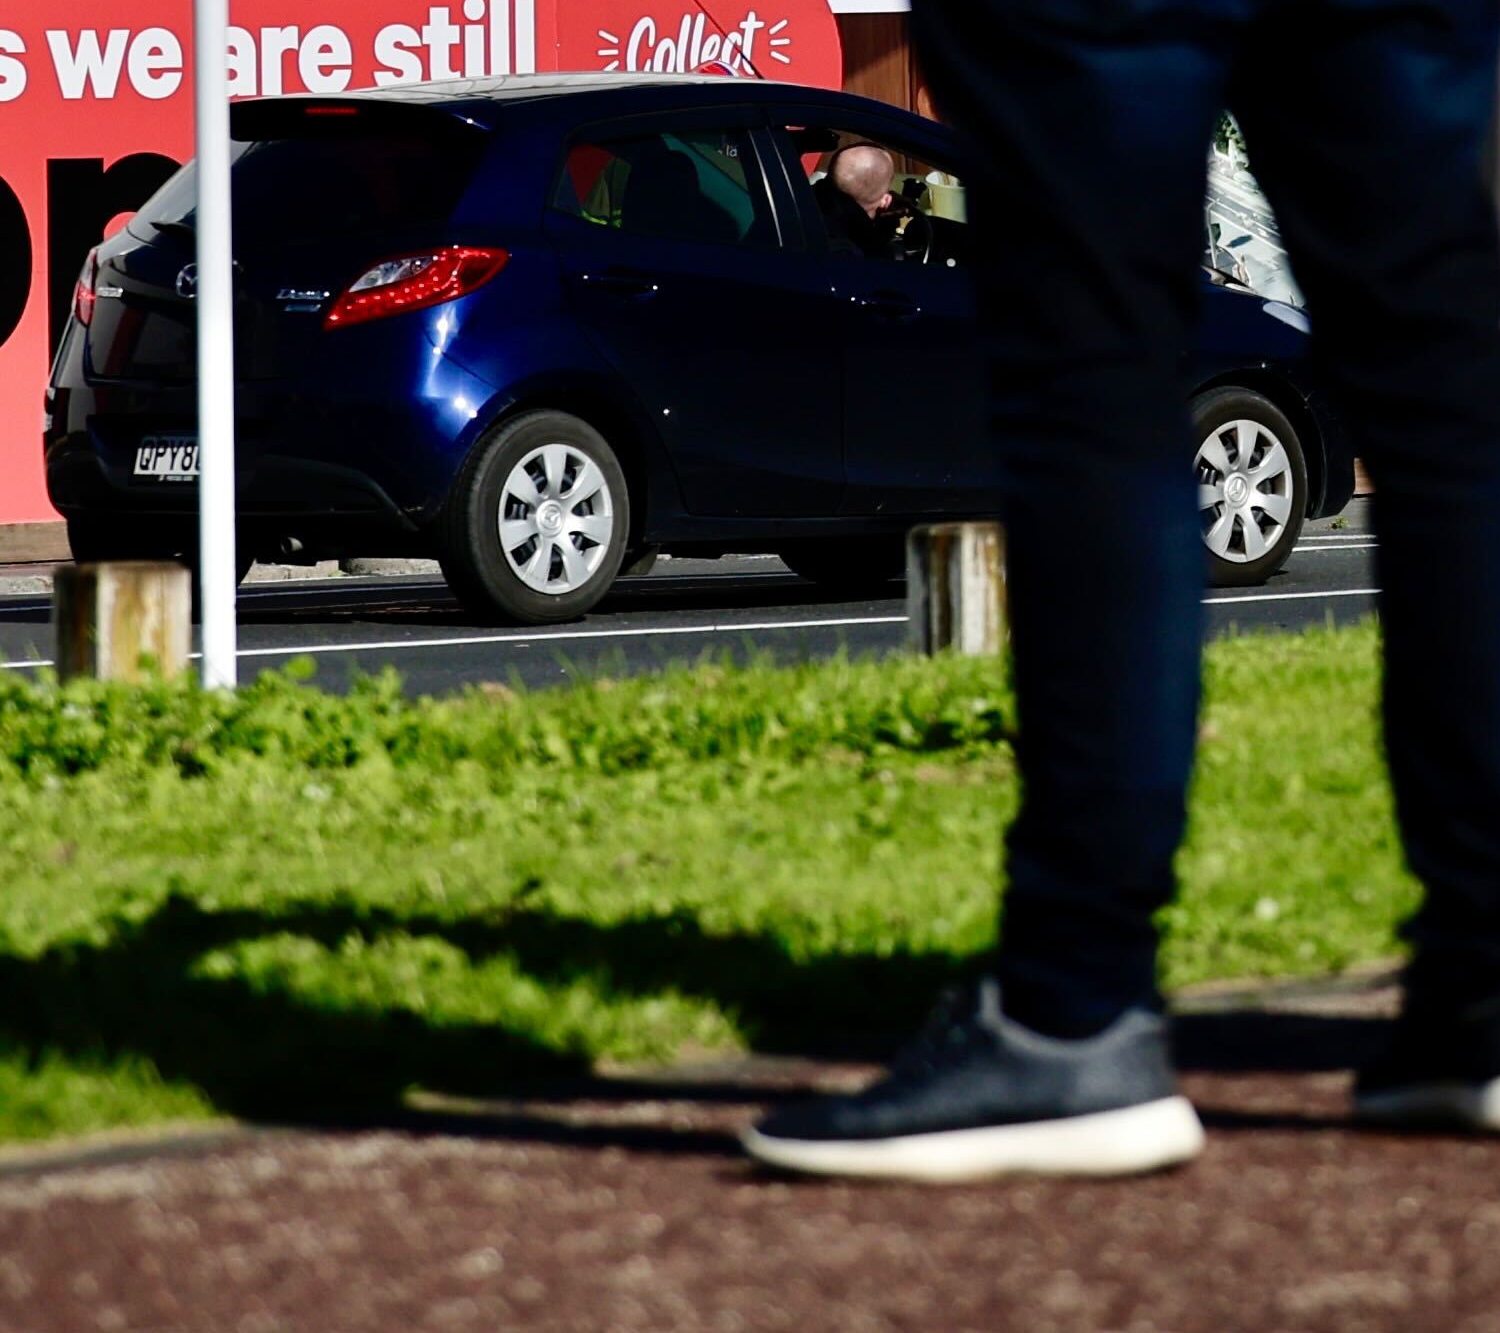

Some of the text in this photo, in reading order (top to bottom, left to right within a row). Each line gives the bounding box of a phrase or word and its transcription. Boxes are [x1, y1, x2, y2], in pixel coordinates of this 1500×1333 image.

[45, 26, 184, 100] we
[224, 24, 353, 97] are
[626, 10, 766, 75] Collect
